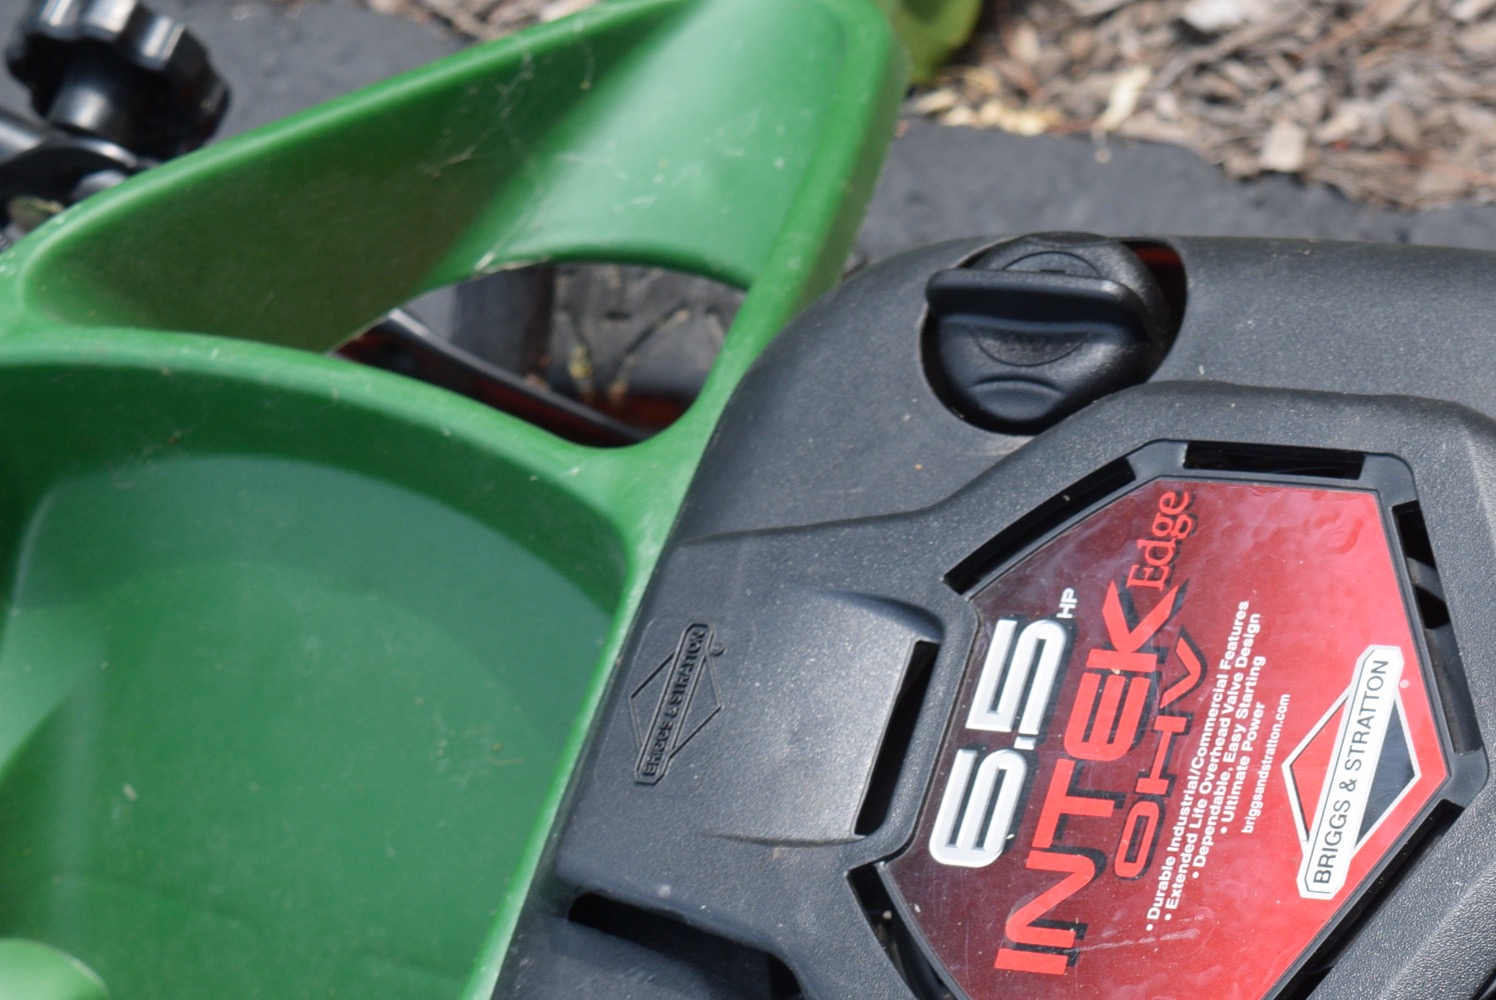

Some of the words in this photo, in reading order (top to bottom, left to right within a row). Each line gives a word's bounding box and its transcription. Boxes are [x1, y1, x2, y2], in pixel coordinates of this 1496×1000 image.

[929, 619, 1067, 869] 6.5
[1055, 587, 1079, 619] HP
[993, 580, 1180, 976] INTEK
[1125, 490, 1196, 592] Edge
[1113, 637, 1202, 879] OHV
[1146, 855, 1176, 920] Durable
[1167, 673, 1229, 852] Industrial/Commercial
[1218, 600, 1250, 671] Features
[1164, 832, 1199, 910] Extended
[1188, 798, 1208, 829] Life
[1198, 717, 1232, 795] Overhead
[1221, 672, 1244, 716] Valve
[1234, 613, 1261, 669] Design
[1192, 767, 1235, 868] Dependable,
[1222, 723, 1247, 763] Easy
[1235, 655, 1267, 720] Starting
[1220, 755, 1251, 823] Ultimate
[1241, 701, 1265, 752] Power
[1240, 693, 1292, 834] briggsandstratton.com
[1339, 778, 1358, 793] &
[1344, 659, 1389, 772] STRATTON
[1313, 799, 1351, 884] BRIGGS
